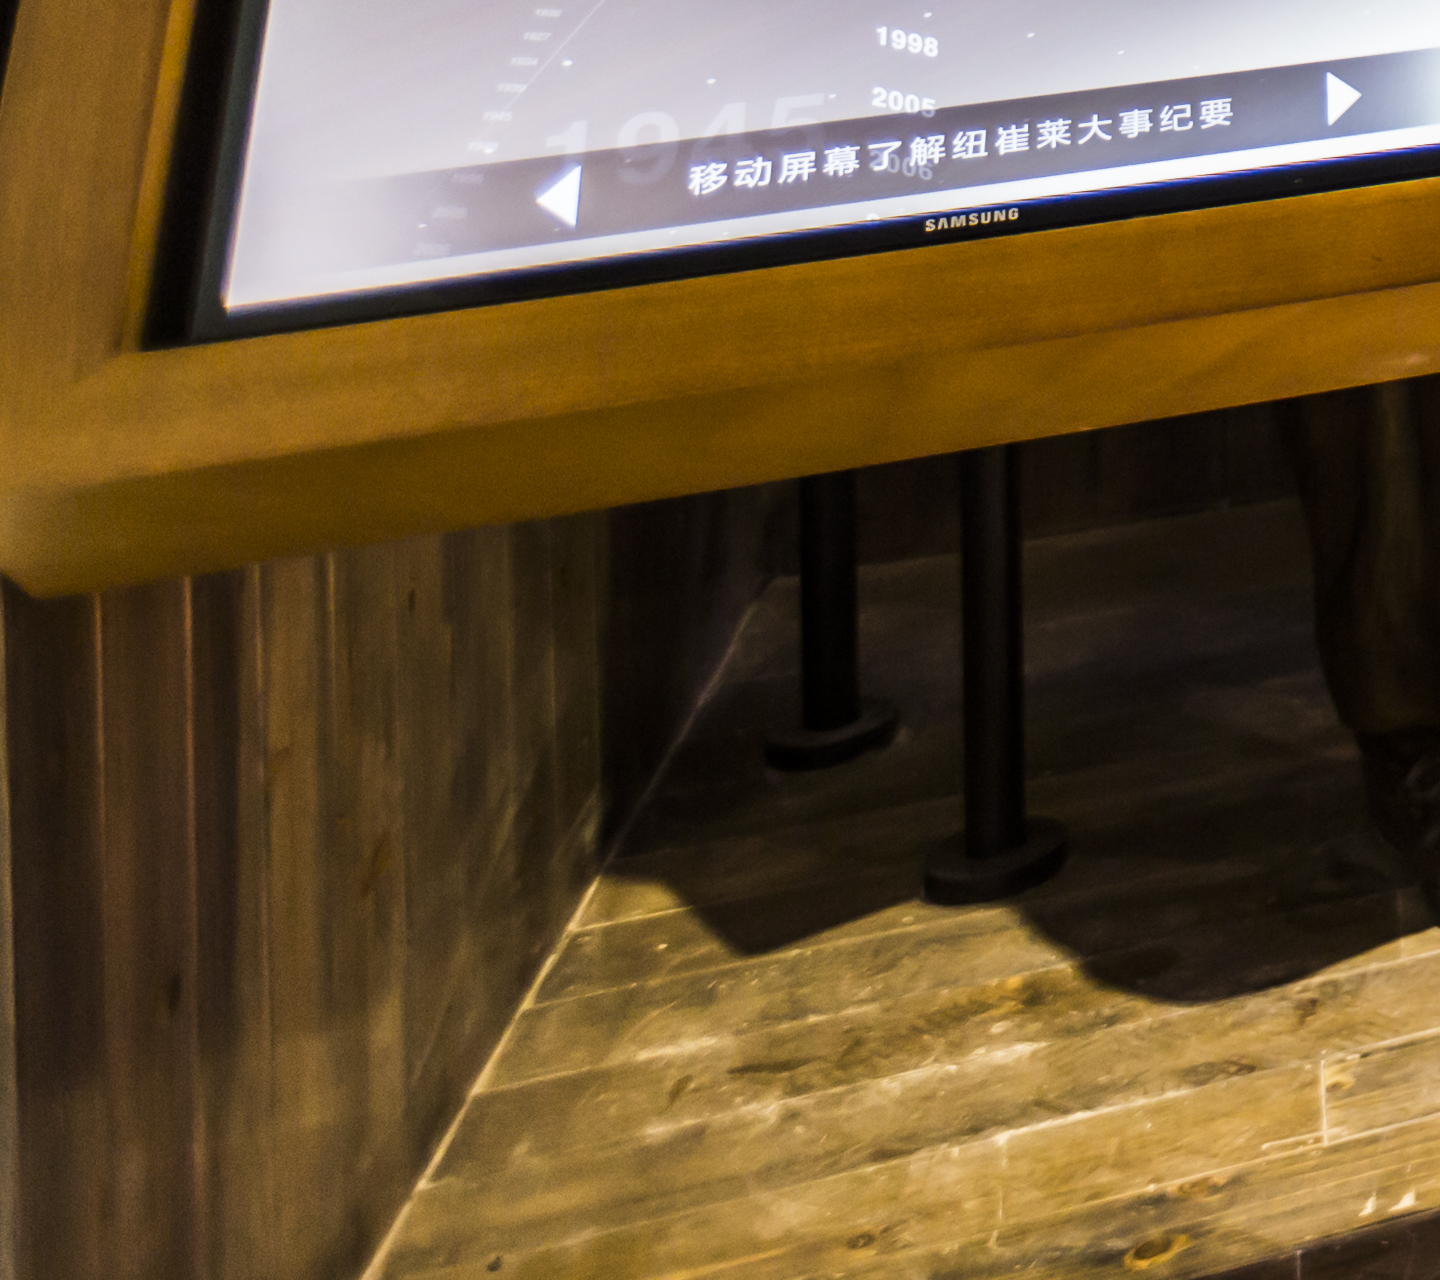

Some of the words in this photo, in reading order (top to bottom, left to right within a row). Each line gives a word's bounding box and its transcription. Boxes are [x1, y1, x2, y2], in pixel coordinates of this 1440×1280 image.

[876, 26, 939, 58] 1998
[872, 87, 937, 119] 2005
[688, 97, 1235, 196] 移动屏幕了解纽崔莱大事纪要
[925, 207, 1019, 233] SAMSUNG
